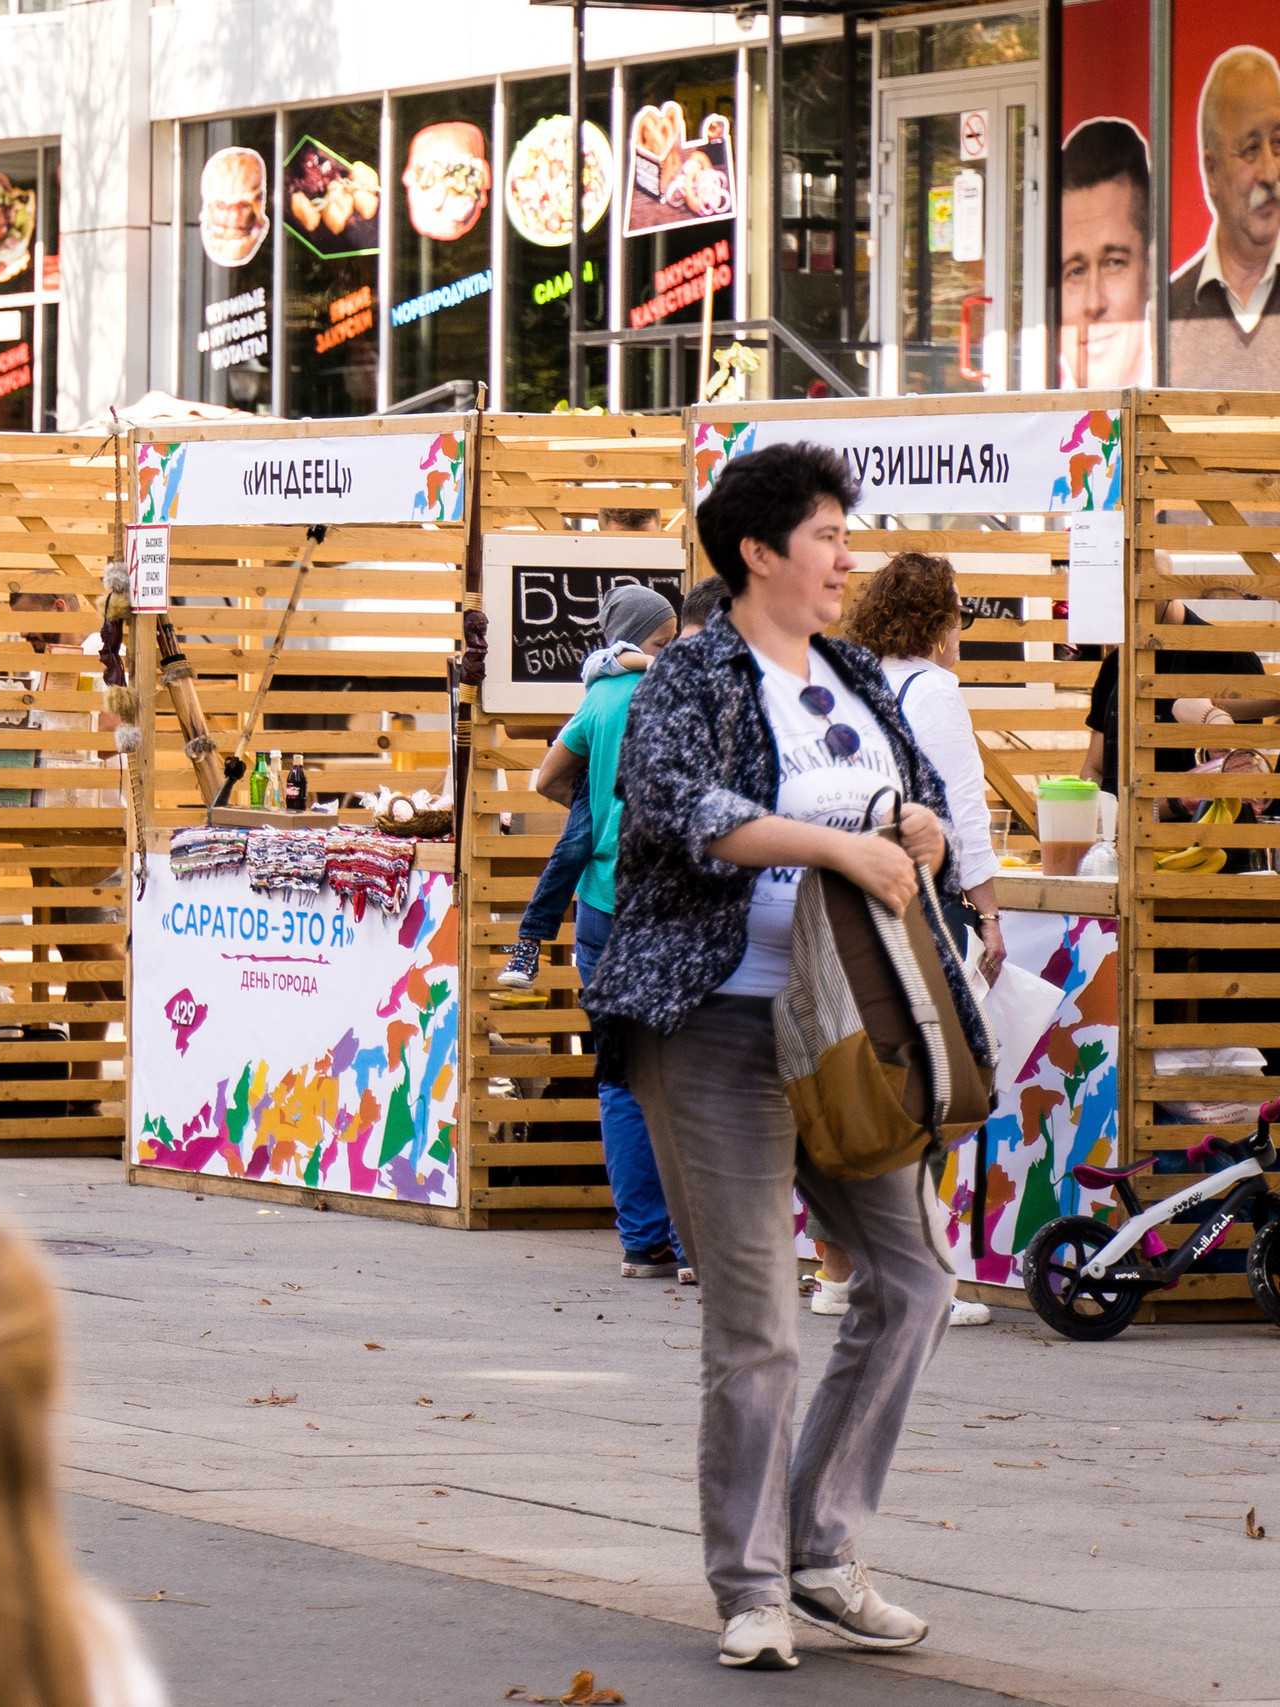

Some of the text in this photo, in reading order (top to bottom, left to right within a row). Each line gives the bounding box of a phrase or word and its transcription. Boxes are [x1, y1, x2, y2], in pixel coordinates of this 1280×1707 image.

[534, 260, 594, 305] САЛАЫ
[655, 240, 730, 293] ВКУСНО И
[391, 269, 493, 327] МОРЕПРОДУКТЫ
[244, 459, 352, 499] «ИНДЕЕЦ»
[817, 791, 870, 804] OLD TIM
[826, 815, 860, 828] Old
[162, 902, 355, 947] «САРАТОВ-ЭТО Я»
[241, 970, 318, 997] ДЕНЬ ГОРОДА
[171, 1000, 197, 1026] 429
